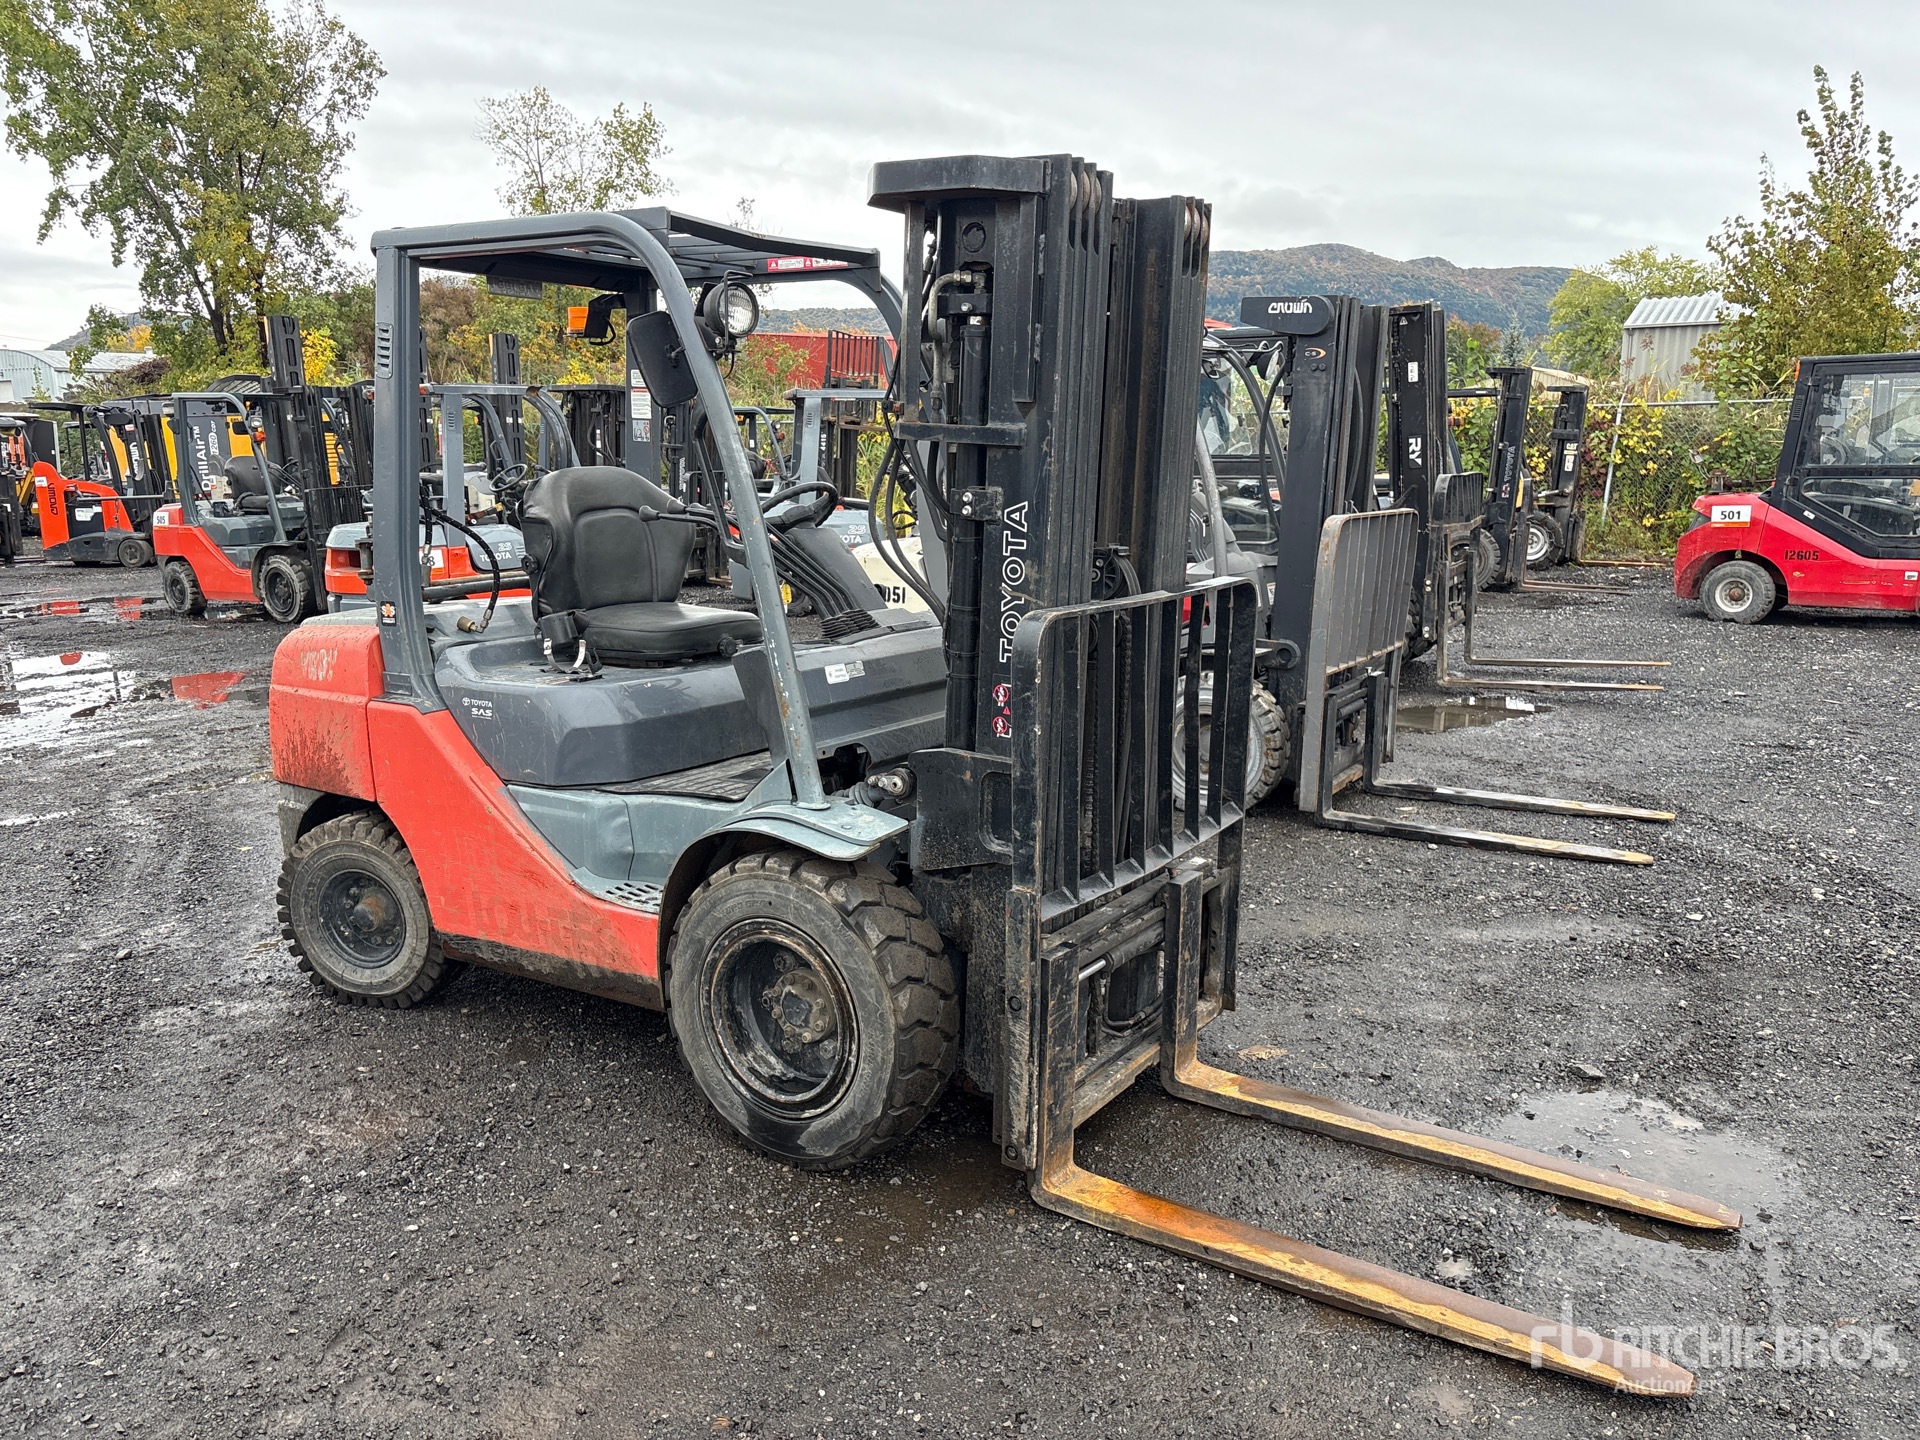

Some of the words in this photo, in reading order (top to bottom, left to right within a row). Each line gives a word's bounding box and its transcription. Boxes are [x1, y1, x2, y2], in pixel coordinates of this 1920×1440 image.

[1268, 300, 1312, 313] CROWN
[48, 483, 59, 516] CROWN
[1720, 510, 1741, 521] 501
[848, 524, 866, 535] 25
[840, 535, 862, 543] OTA
[498, 542, 512, 551] 25
[480, 552, 511, 562] TOOTA
[1785, 550, 1819, 561] 12605
[1000, 501, 1029, 663] TOYOTA
[471, 699, 493, 708] TOYOTA
[471, 708, 493, 717] SAS
